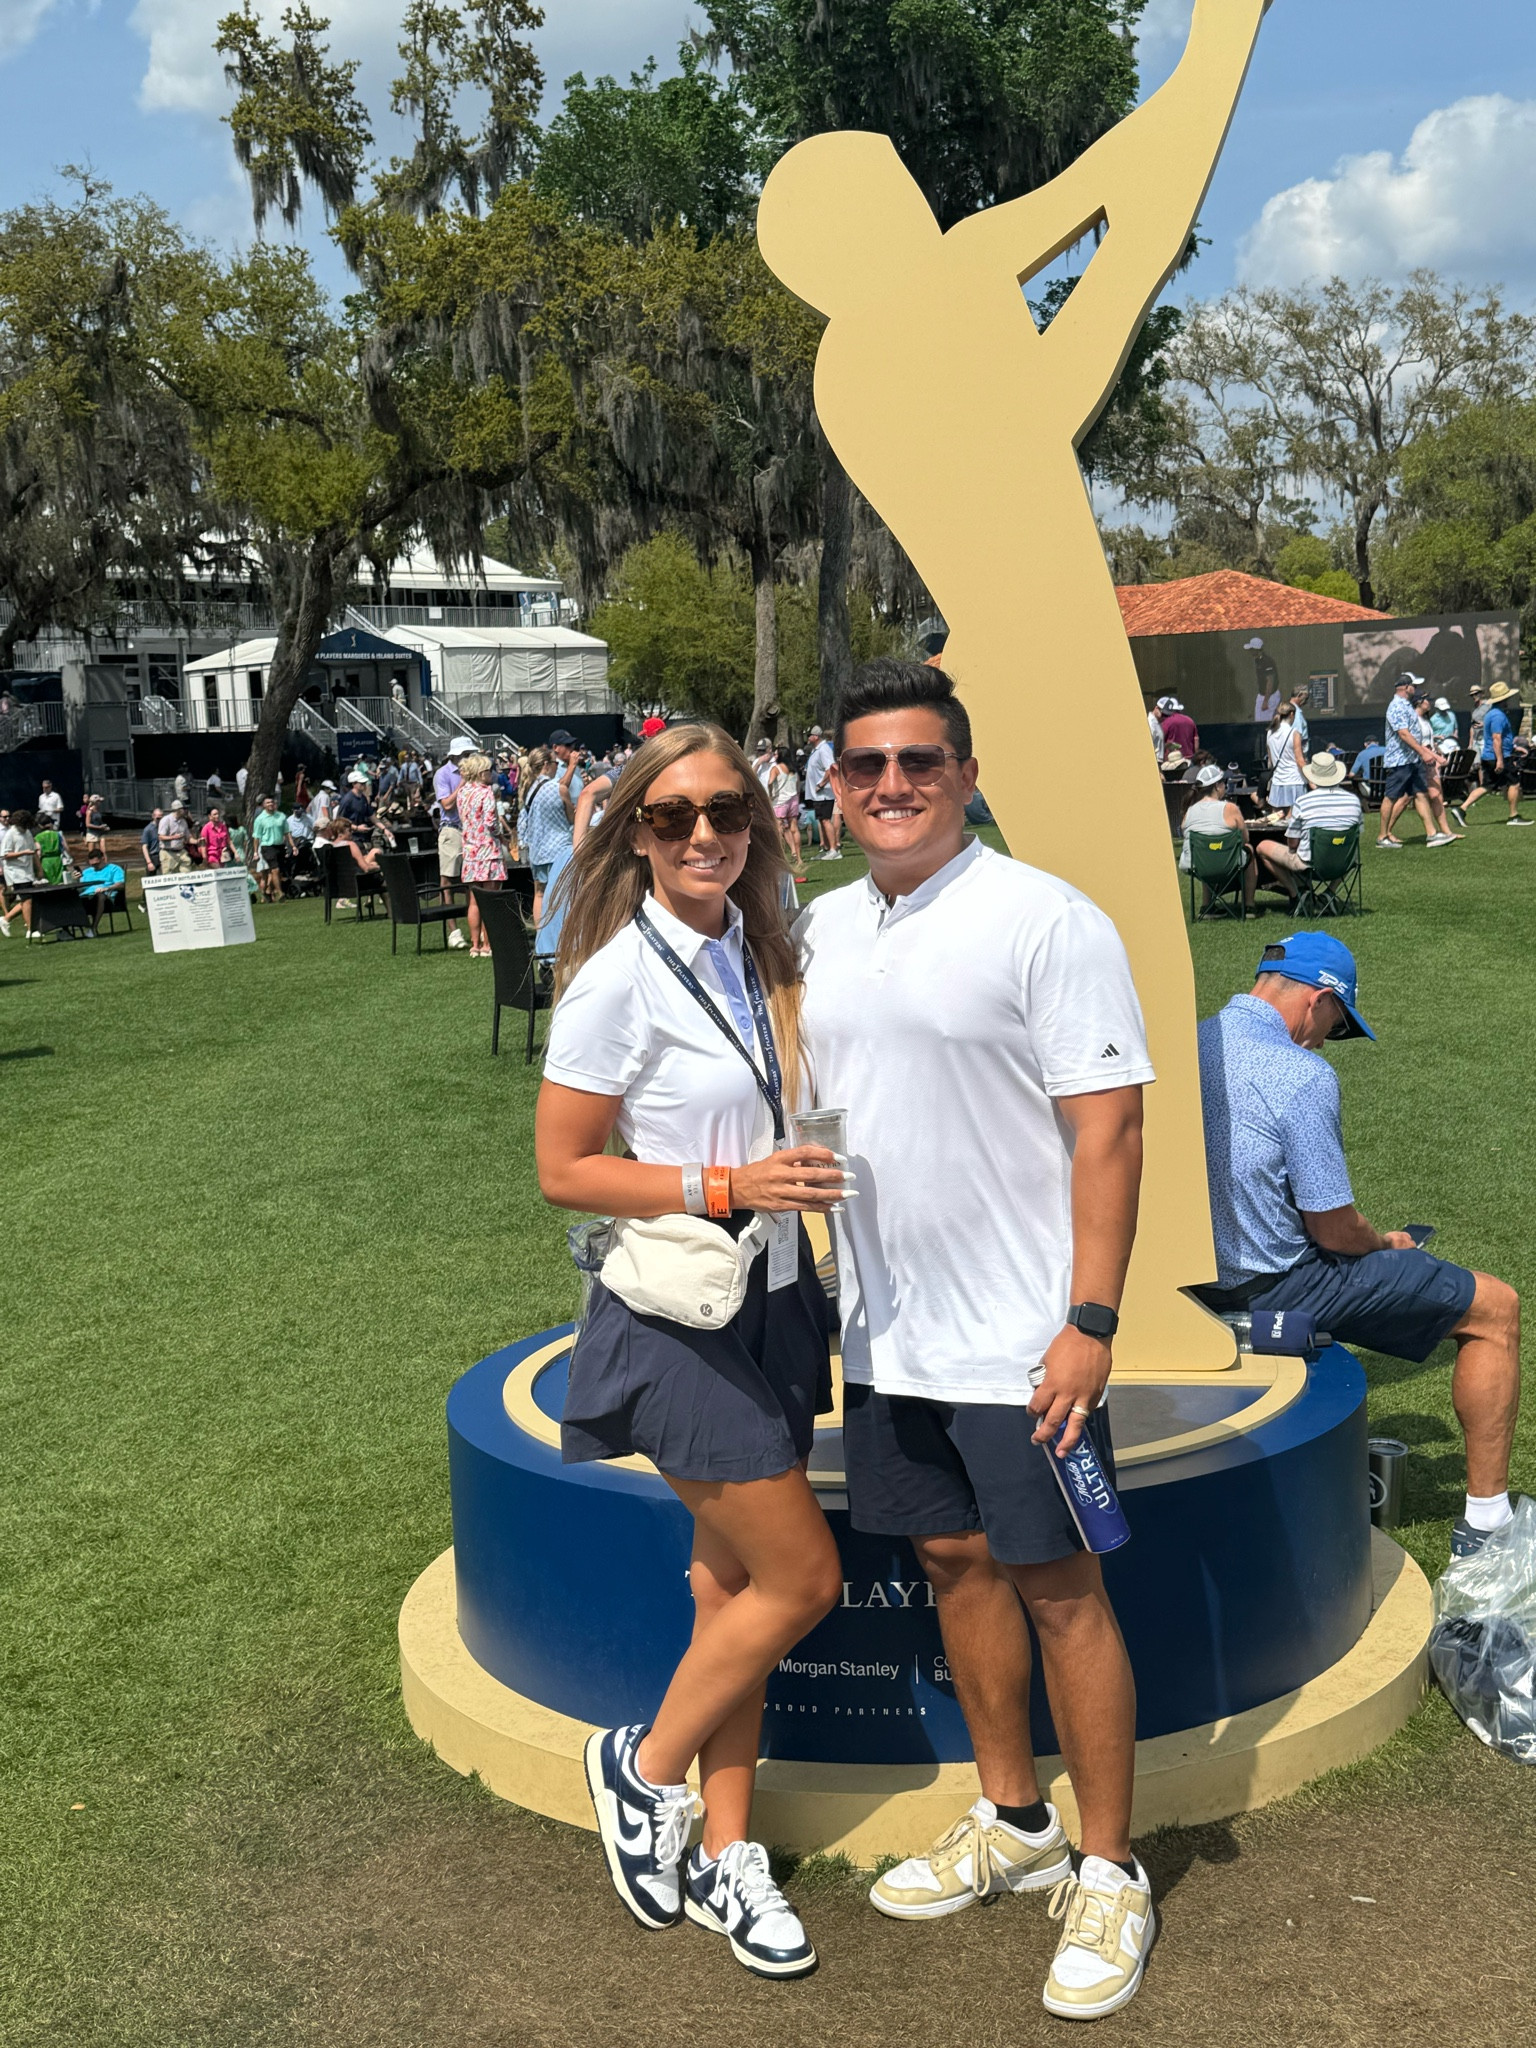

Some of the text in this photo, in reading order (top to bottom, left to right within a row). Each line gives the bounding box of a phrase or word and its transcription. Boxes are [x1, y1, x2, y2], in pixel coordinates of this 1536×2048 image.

[320, 652, 342, 660] PLAYERS
[343, 652, 370, 660] MARQUEES
[376, 652, 394, 660] ISLAND
[646, 930, 664, 951] PLAYERS
[666, 955, 695, 990] THE PLAYERS
[761, 1022, 771, 1048] PLAYERS
[1067, 1461, 1093, 1504] Michelob
[1076, 1440, 1110, 1509] ULTRA
[779, 1658, 900, 1680] Morgan Stanley
[763, 1702, 926, 1717] PROUD PARTNERS
